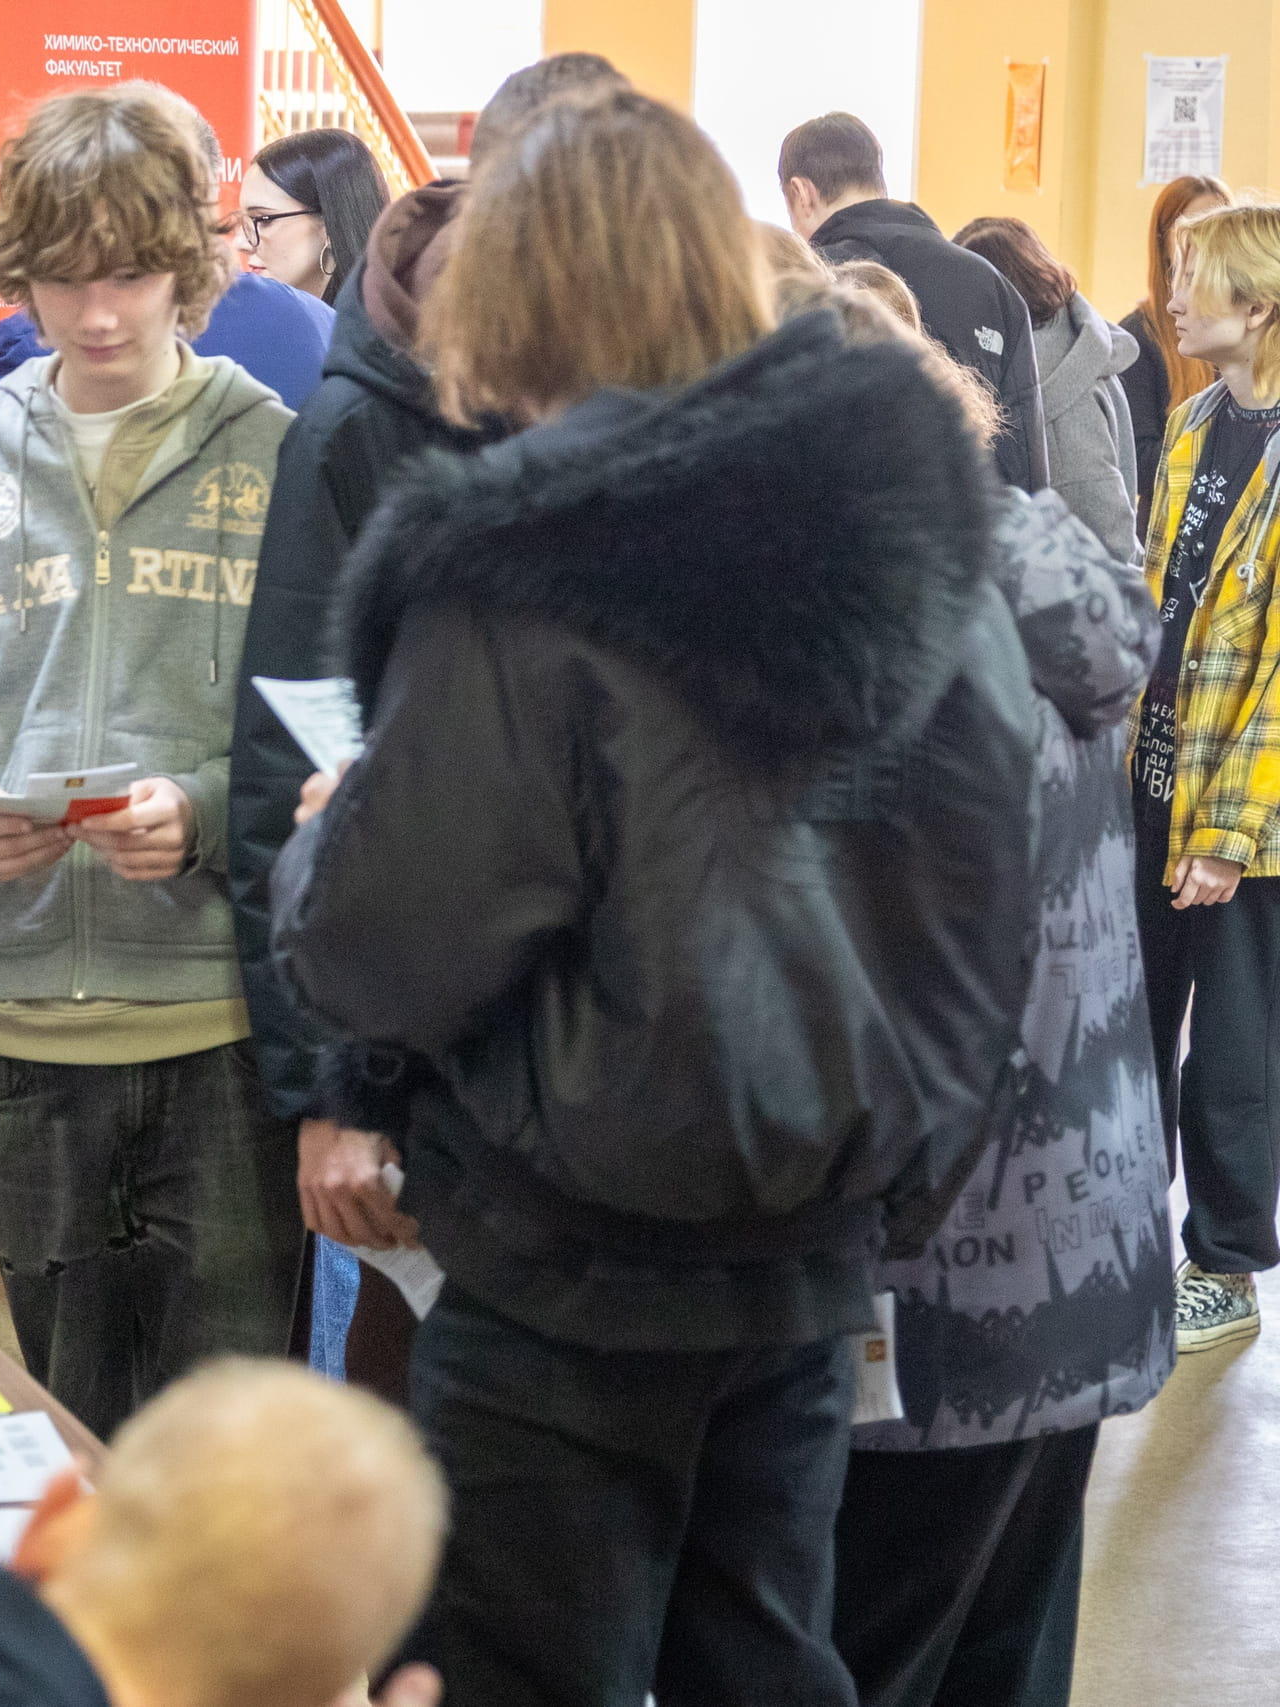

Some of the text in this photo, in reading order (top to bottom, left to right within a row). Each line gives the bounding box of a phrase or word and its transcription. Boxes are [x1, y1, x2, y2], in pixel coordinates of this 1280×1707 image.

[44, 34, 240, 56] ХИМИКО-ТЕХНОЛОГИЧЕСКИЙ
[45, 59, 122, 77] ФАКУЛЬТЕТ
[126, 546, 258, 606] RTIN
